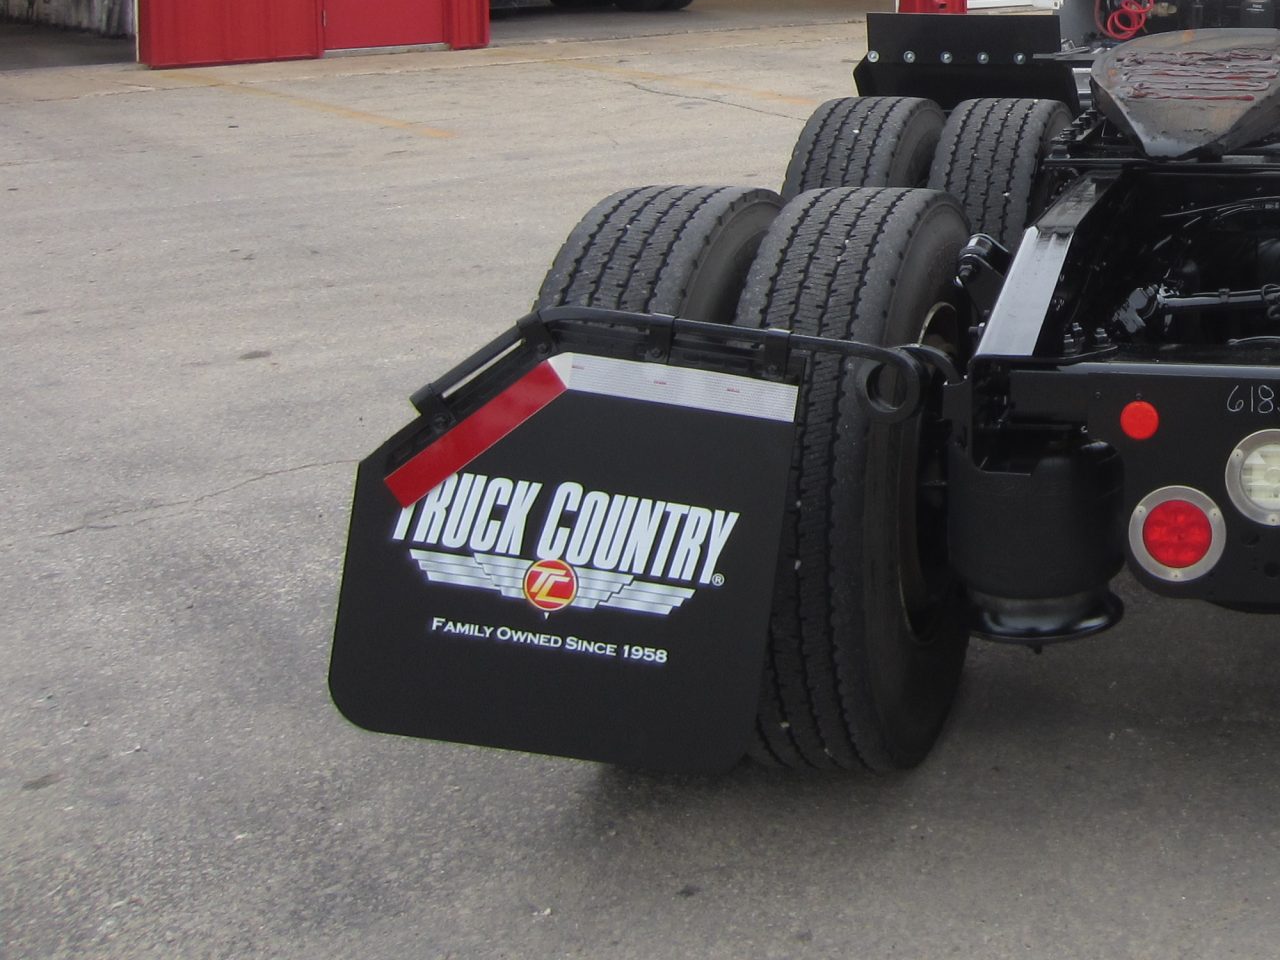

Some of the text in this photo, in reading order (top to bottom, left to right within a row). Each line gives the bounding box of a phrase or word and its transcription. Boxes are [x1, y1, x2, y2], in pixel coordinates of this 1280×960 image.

[536, 481, 740, 584] COUNTRY
[431, 617, 668, 664] FAMILY OWNED SINCE 1958
